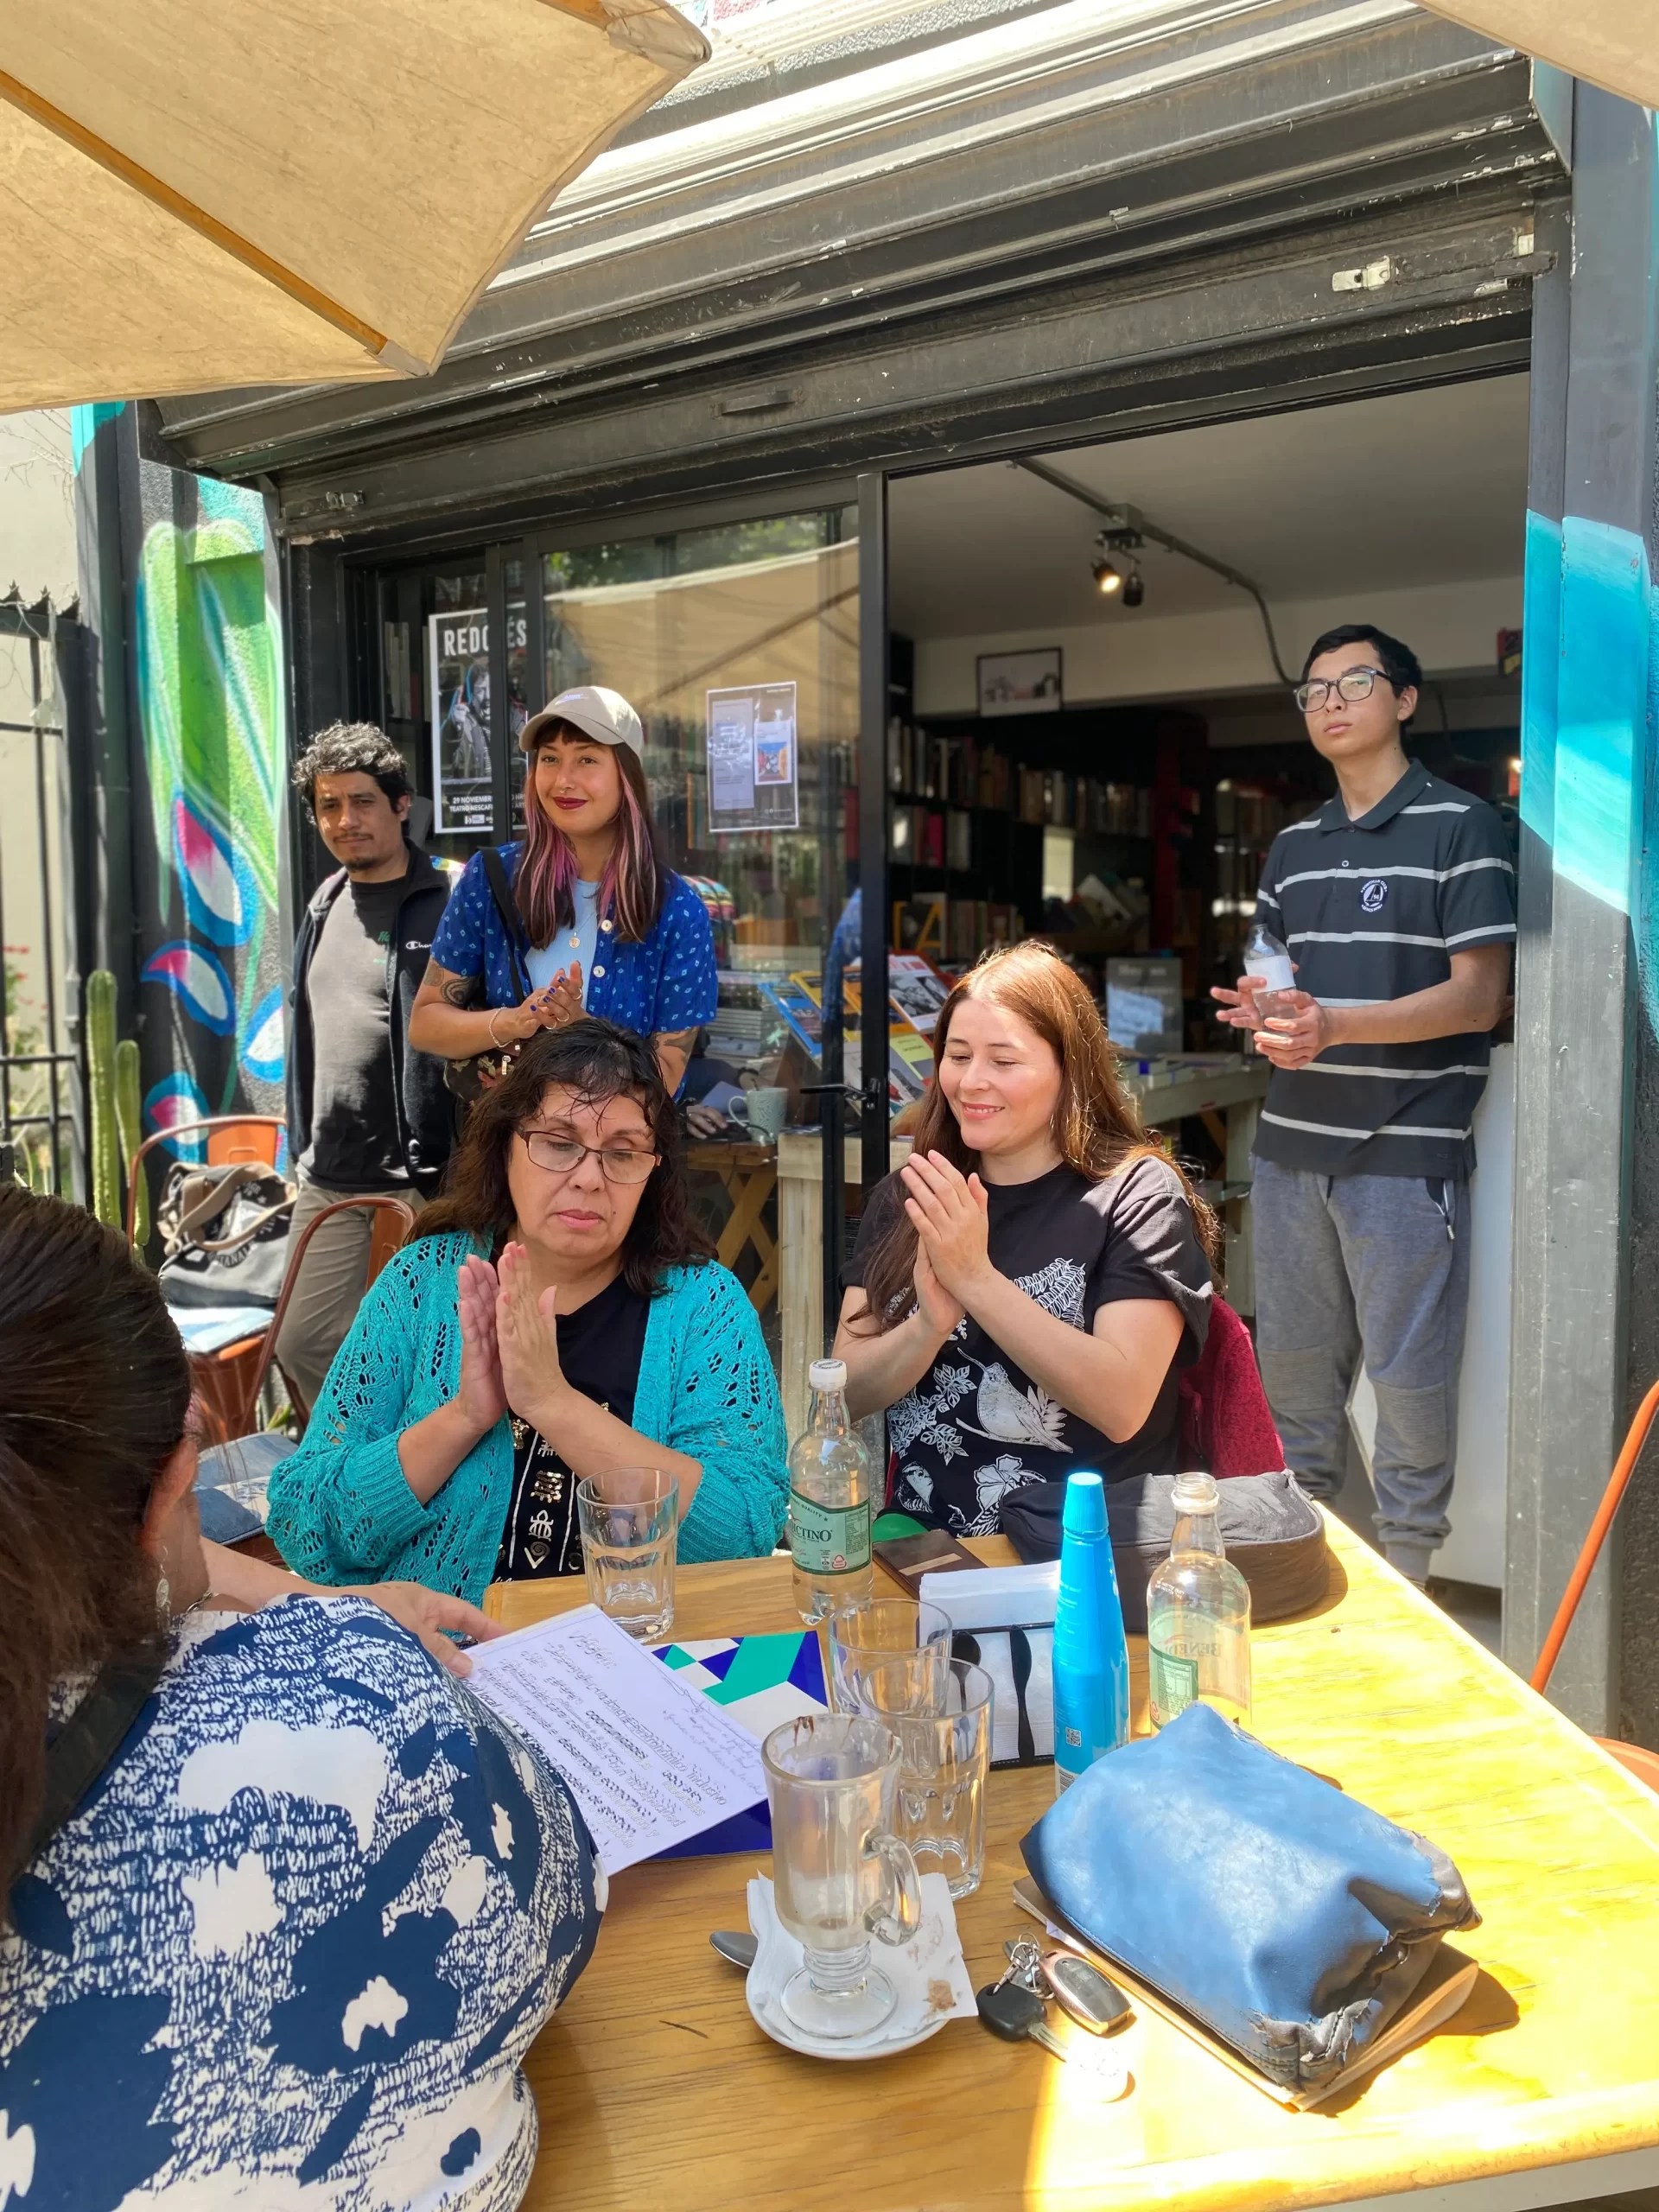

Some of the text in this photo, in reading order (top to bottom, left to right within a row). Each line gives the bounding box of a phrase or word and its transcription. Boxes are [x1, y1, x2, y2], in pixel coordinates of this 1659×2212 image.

[444, 616, 526, 656] REDOÉS
[461, 795, 493, 804] NOVIEMBR
[477, 1688, 503, 1712] local
